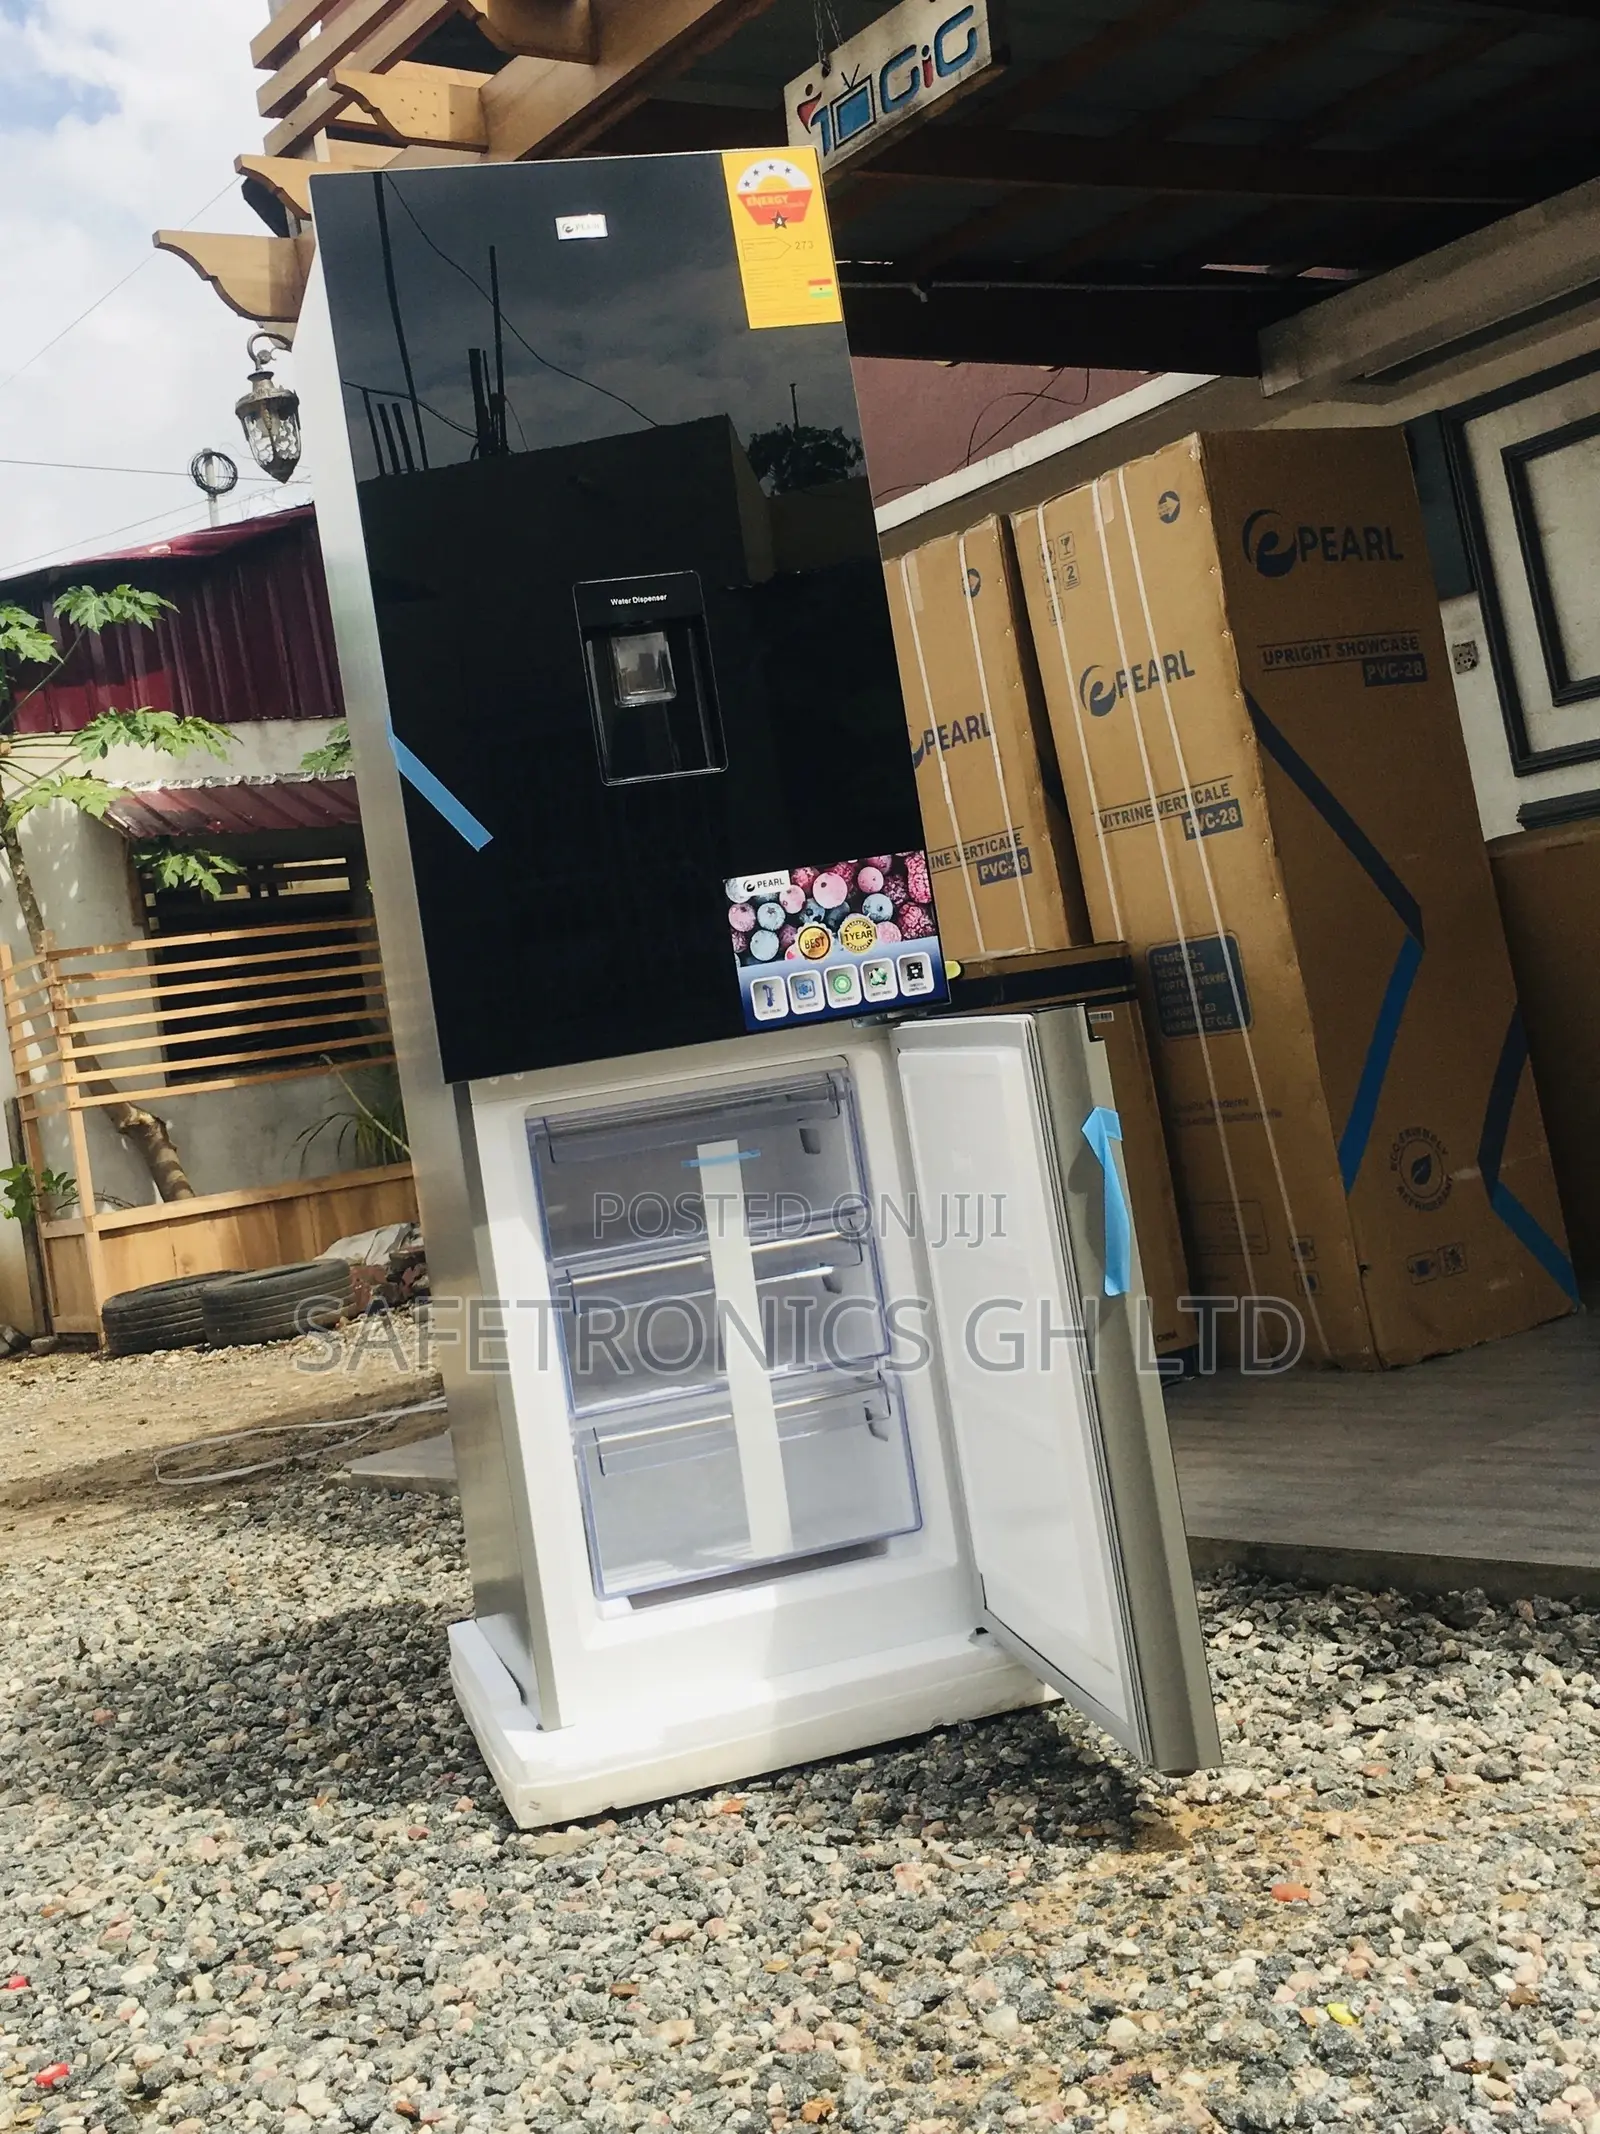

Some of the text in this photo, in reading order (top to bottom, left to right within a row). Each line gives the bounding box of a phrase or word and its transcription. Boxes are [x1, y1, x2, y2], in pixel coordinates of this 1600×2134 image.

[795, 240, 814, 250] 273
[1299, 526, 1404, 562] PEARL
[610, 594, 667, 606] Water Dispenser
[1263, 636, 1420, 665] UPRIGHT SHOWCASE
[1116, 650, 1196, 699] PEARL
[1365, 660, 1424, 681] PVC-28
[923, 712, 991, 755] PEARL
[1099, 804, 1154, 829] VITRINE
[756, 878, 785, 889] PEARL
[804, 934, 825, 950] BEST
[849, 929, 873, 941] YEAR
